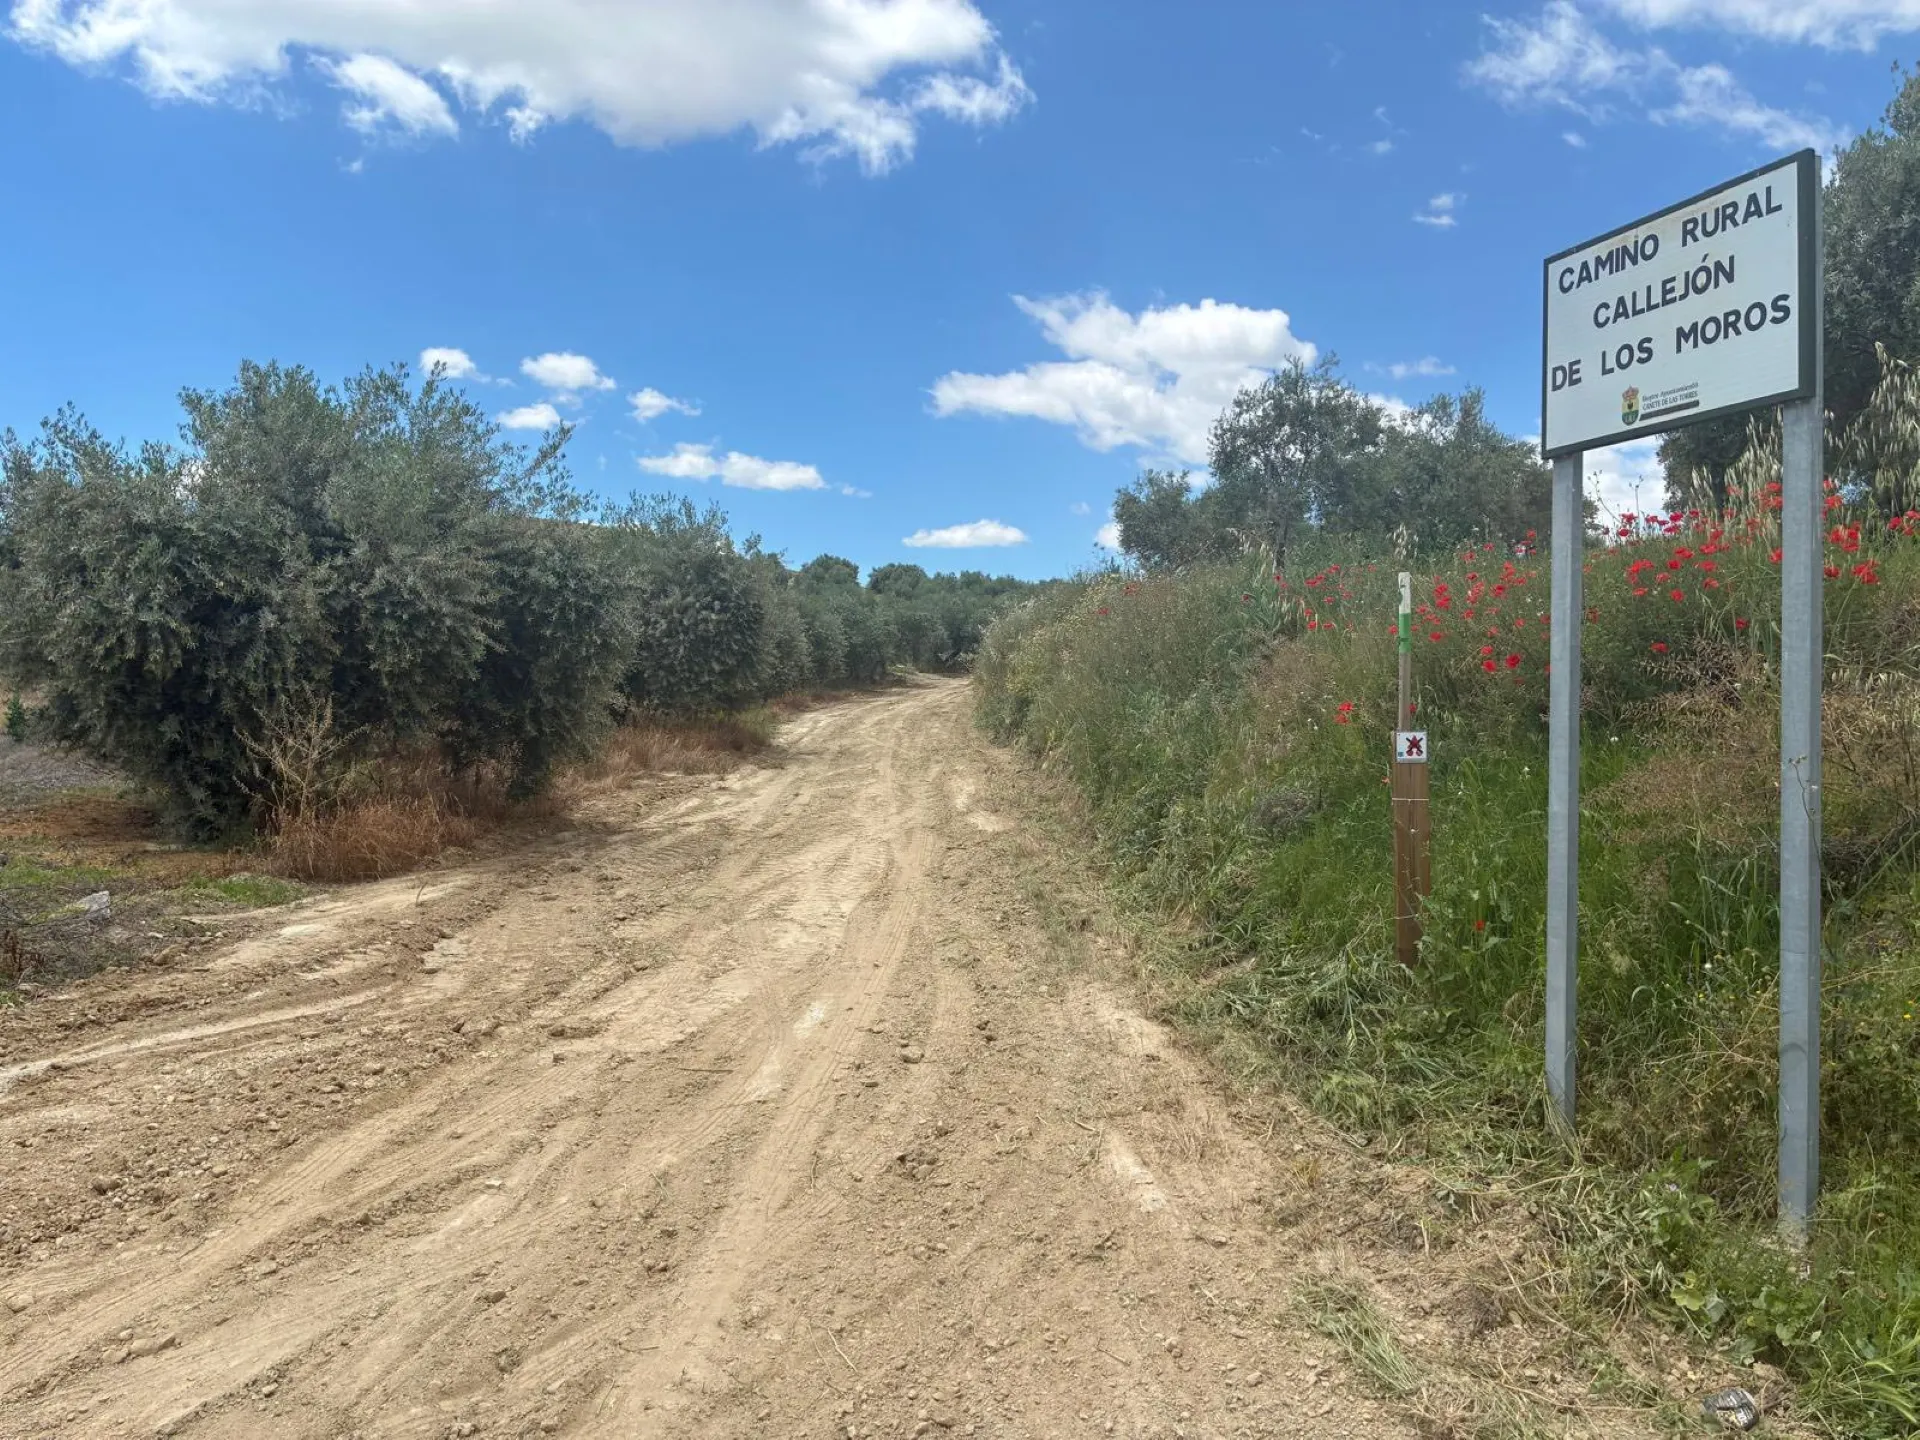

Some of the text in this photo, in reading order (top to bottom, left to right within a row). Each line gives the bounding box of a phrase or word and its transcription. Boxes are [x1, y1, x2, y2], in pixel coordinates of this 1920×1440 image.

[1559, 186, 1782, 294] CAMINO RURAL
[1593, 254, 1734, 329] CALLEJÓN
[1551, 294, 1791, 391] DE LOS MOROS
